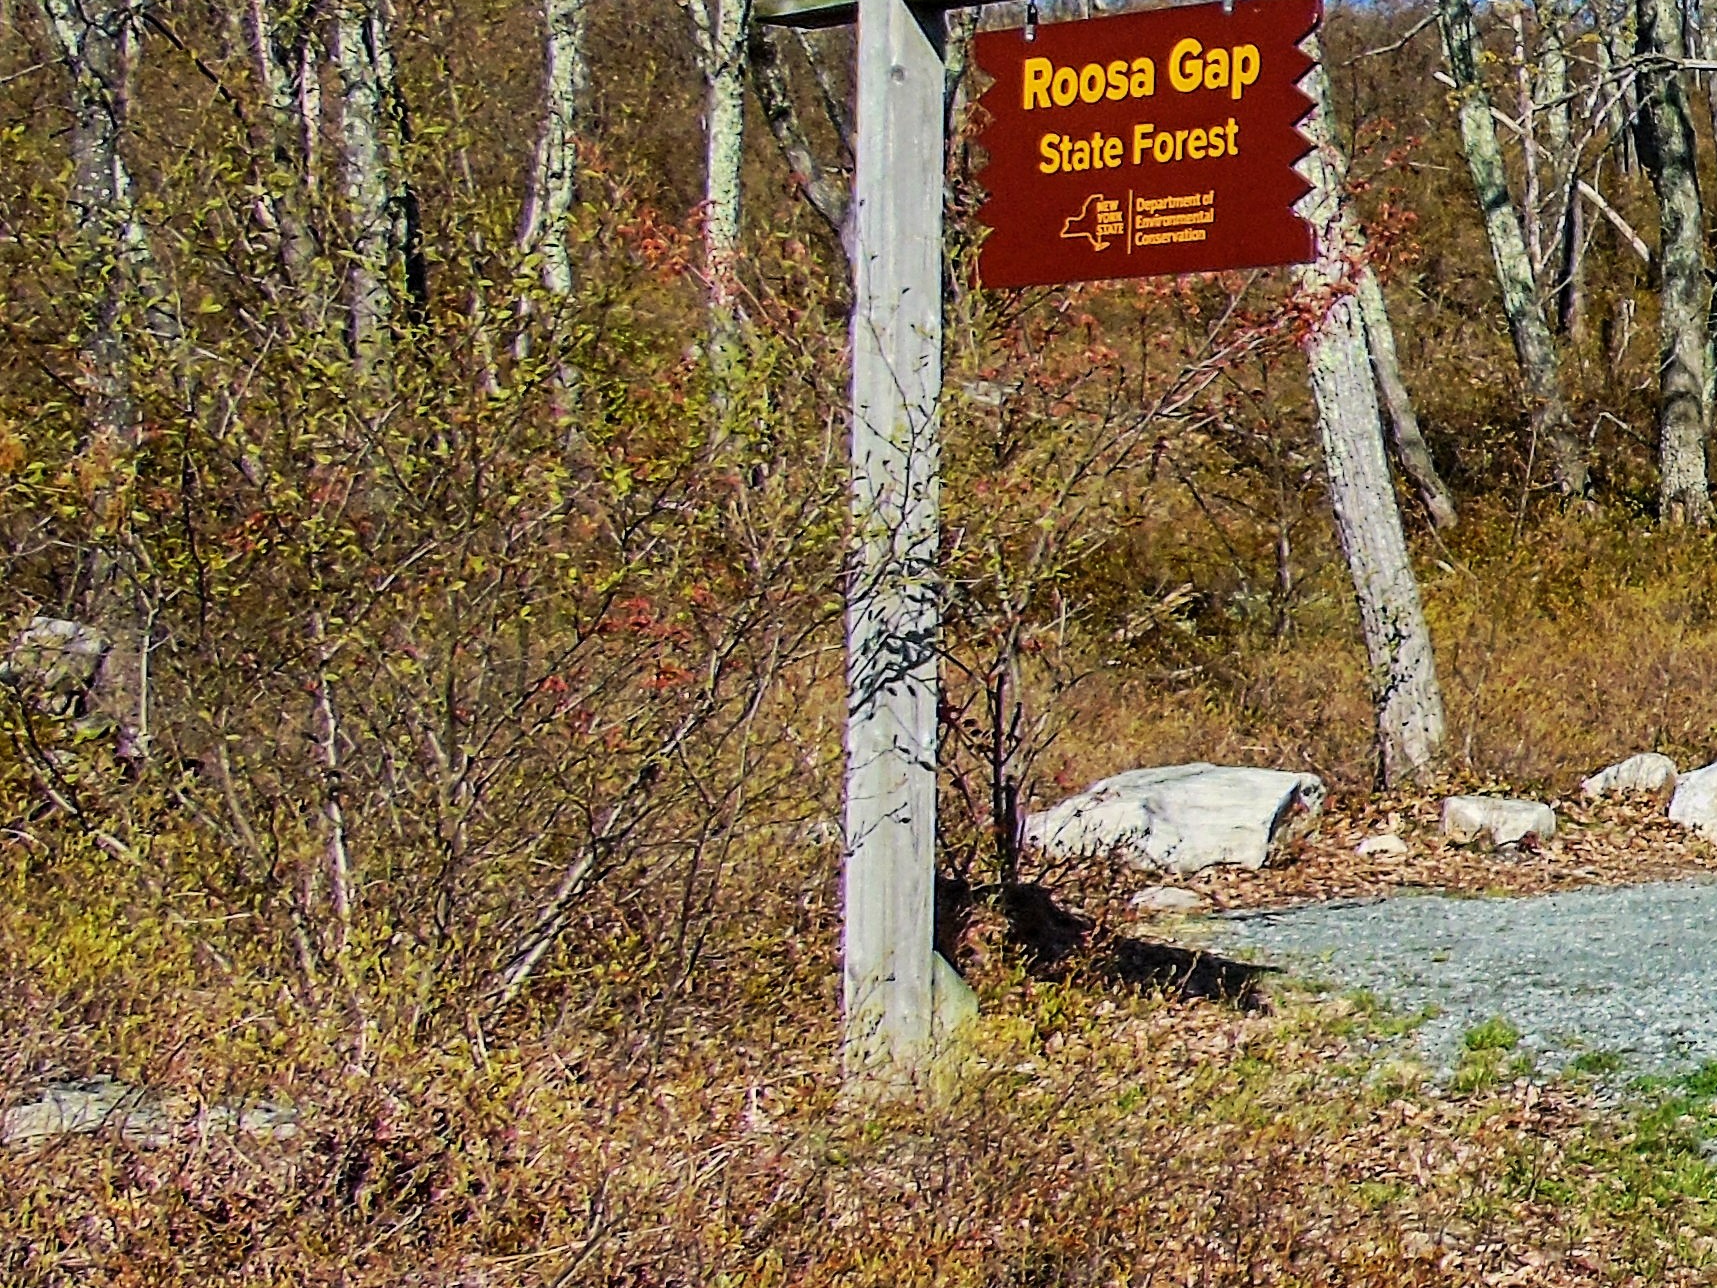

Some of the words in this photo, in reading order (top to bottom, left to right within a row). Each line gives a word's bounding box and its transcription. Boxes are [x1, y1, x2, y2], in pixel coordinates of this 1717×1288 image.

[1022, 56, 1155, 110] Roosa
[1168, 37, 1261, 100] Gap
[1038, 131, 1124, 174] State
[1133, 117, 1239, 165] Forest
[1097, 199, 1119, 212] NEW
[1135, 193, 1201, 214] Department
[1202, 190, 1215, 205] of
[1097, 211, 1123, 223] YORK
[1135, 207, 1215, 229] Environmental
[1095, 222, 1124, 235] STATE
[1134, 228, 1206, 246] Conservation
